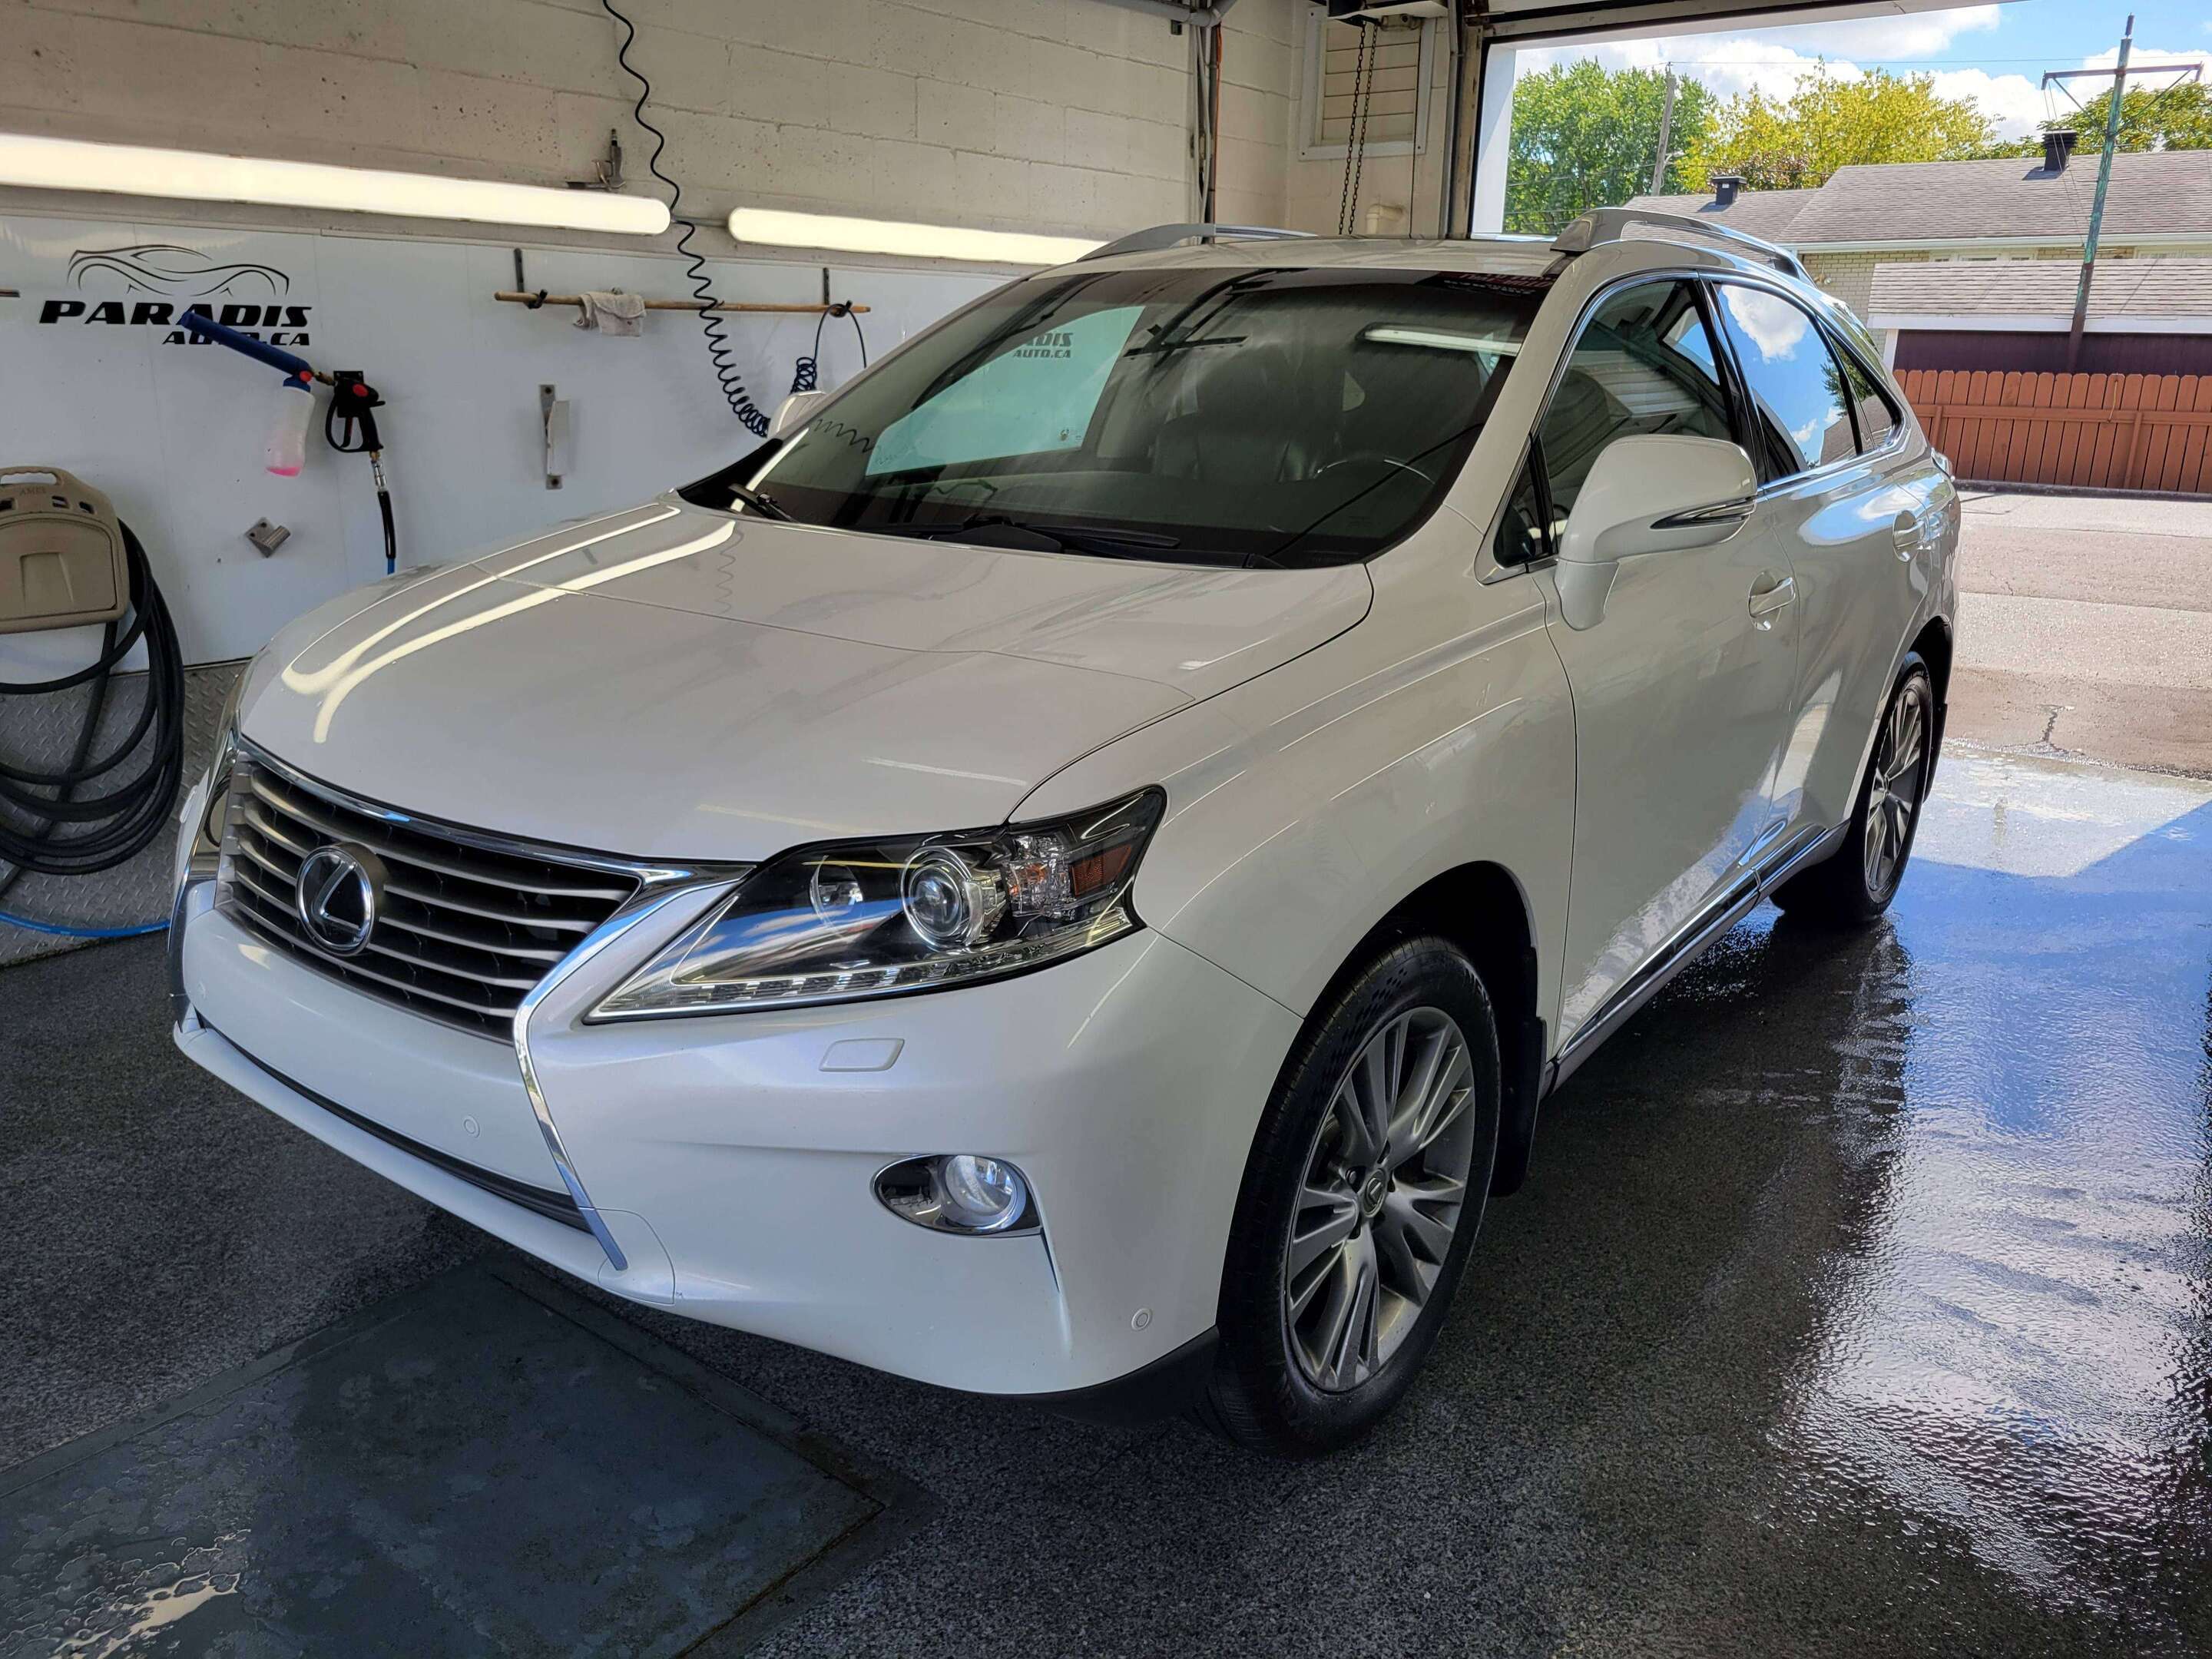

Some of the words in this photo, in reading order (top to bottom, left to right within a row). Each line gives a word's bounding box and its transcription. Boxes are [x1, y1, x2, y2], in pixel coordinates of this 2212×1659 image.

[39, 300, 312, 327] PARADIS
[162, 331, 310, 346] AU.CA
[1013, 349, 1071, 359] AUTO.CA
